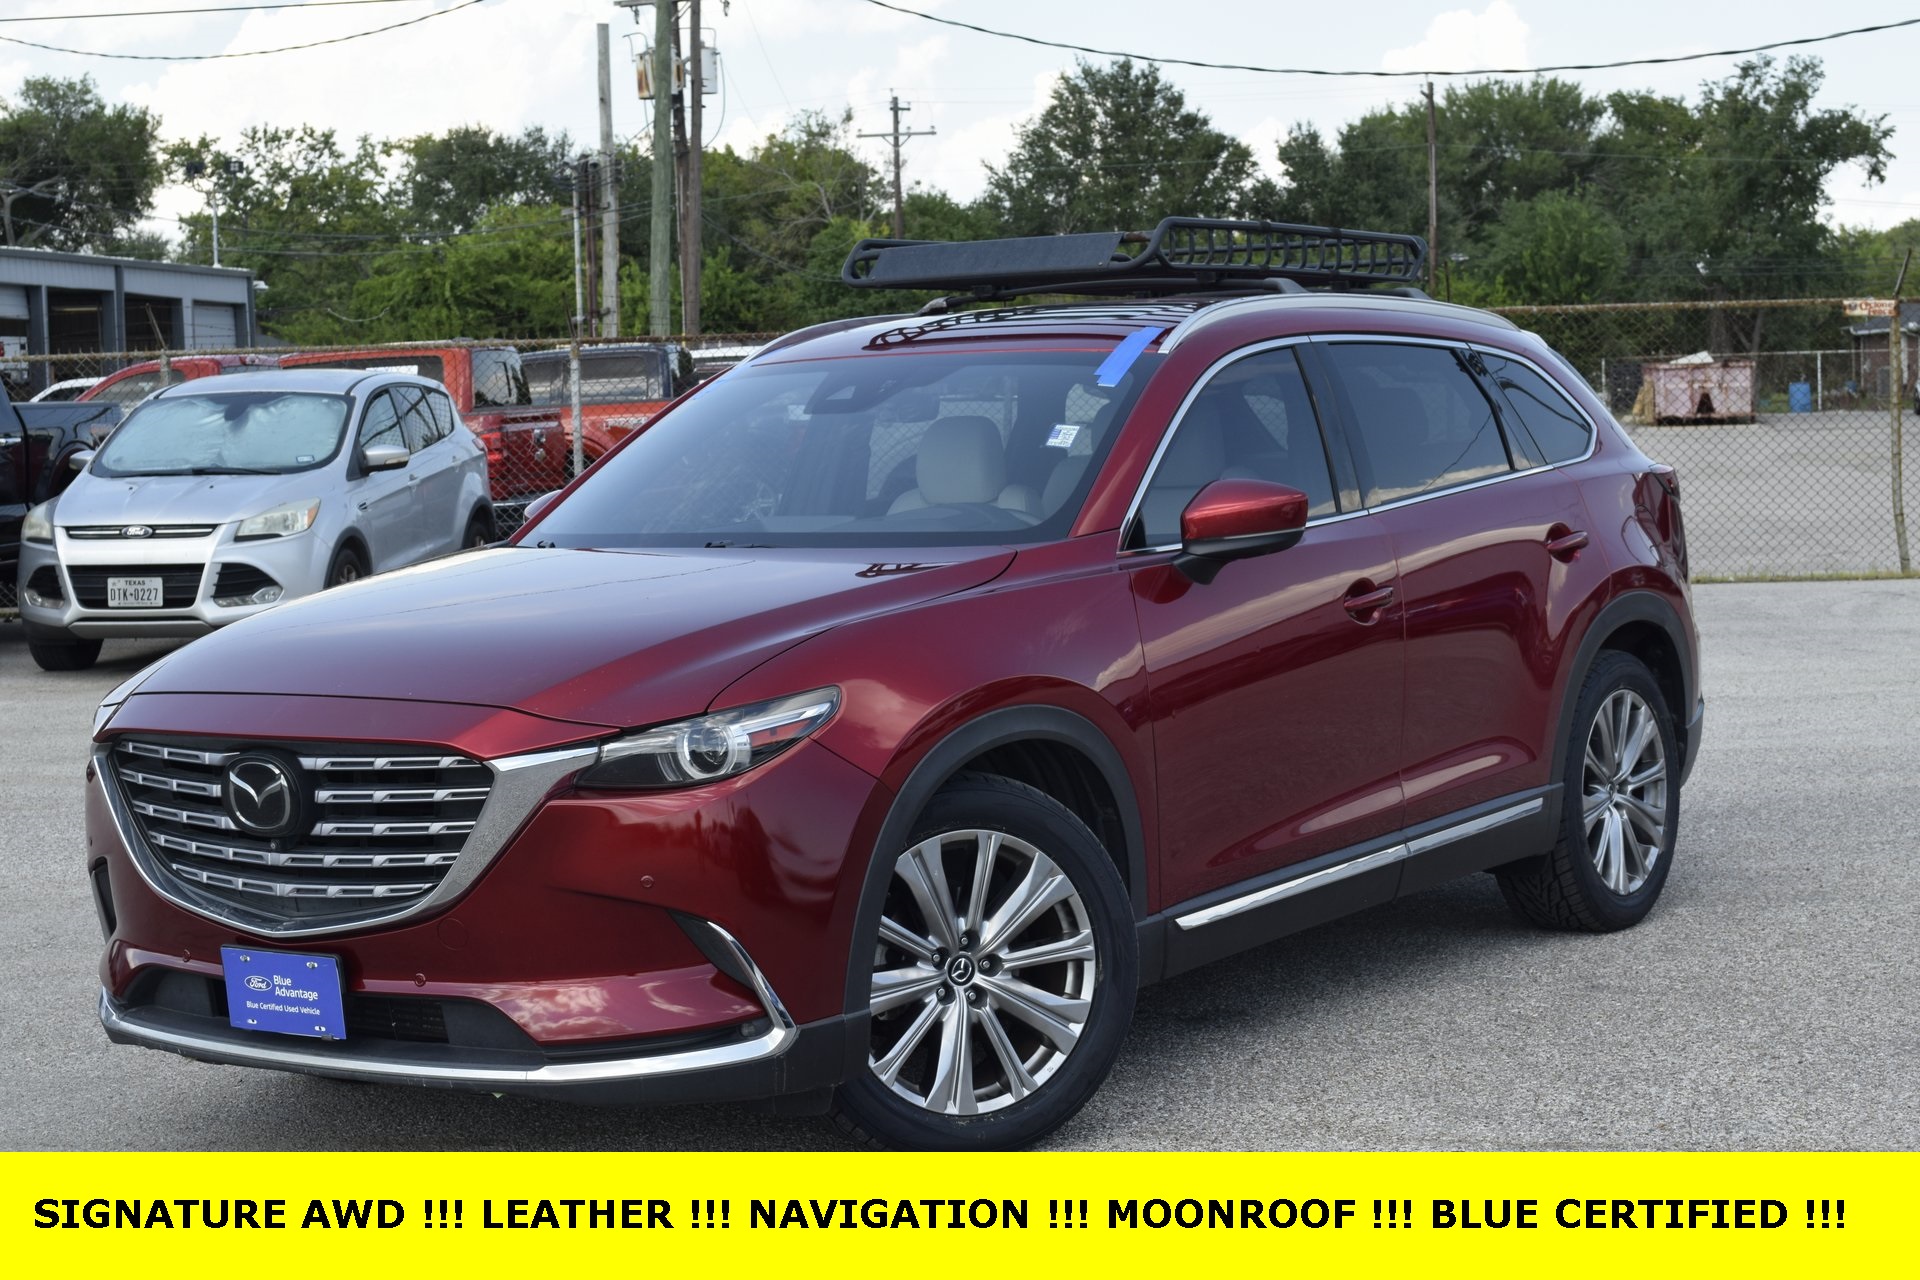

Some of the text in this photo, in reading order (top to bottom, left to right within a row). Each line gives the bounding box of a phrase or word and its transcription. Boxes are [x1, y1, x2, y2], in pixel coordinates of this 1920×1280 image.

[249, 977, 267, 989] Ford
[273, 975, 292, 986] Blue
[275, 986, 319, 1001] Advantage
[246, 1000, 321, 1016] Blue Certified Used Vehicle
